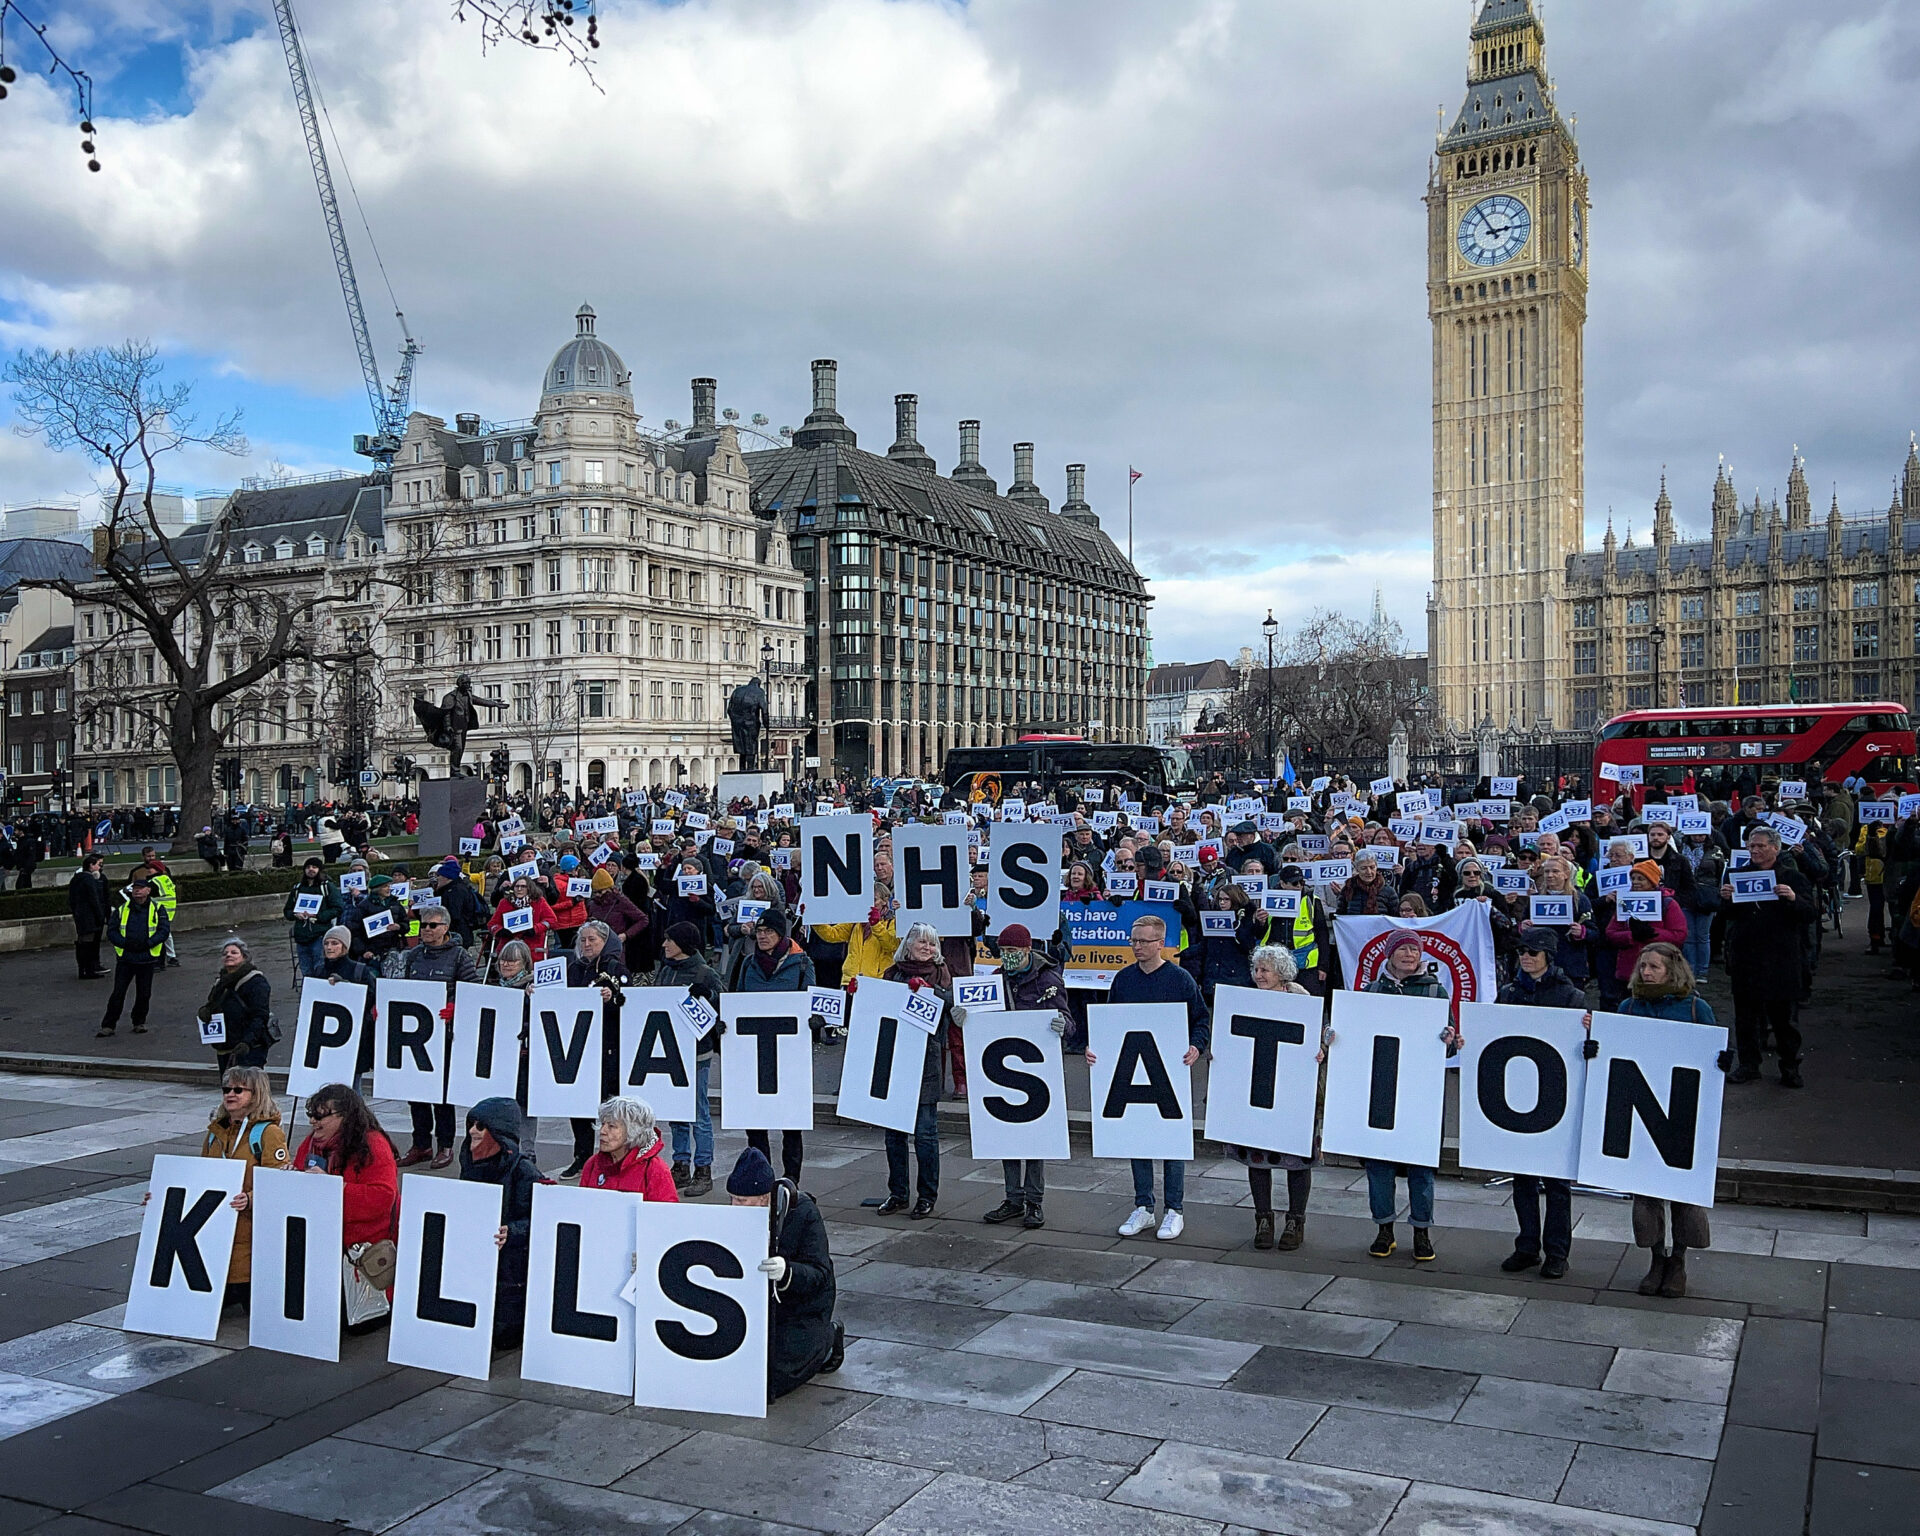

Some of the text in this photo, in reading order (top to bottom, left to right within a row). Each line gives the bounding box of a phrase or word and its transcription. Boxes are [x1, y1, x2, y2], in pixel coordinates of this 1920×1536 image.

[1407, 801, 1426, 811] 146
[1484, 805, 1504, 813] 363
[1648, 811, 1670, 820] 554
[1866, 808, 1886, 817] 211
[1395, 825, 1413, 834] 178
[1684, 820, 1705, 829] 557
[1431, 829, 1448, 839] 63
[1304, 840, 1321, 849] 116
[1322, 866, 1346, 878] 450
[685, 881, 698, 890] 29
[1116, 880, 1131, 889] 34
[1503, 877, 1520, 887] 38
[1605, 875, 1621, 887] 41
[1745, 880, 1763, 892] 16
[1243, 882, 1258, 892] 35
[1155, 889, 1168, 899] 11
[305, 900, 312, 908] 1
[1274, 898, 1289, 909] 13
[1630, 899, 1648, 911] 15
[1543, 904, 1560, 915] 14
[1084, 908, 1117, 922] have
[375, 919, 384, 928] 2
[515, 917, 522, 926] 4
[1212, 918, 1226, 929] 12
[1089, 951, 1127, 964] lives.
[538, 967, 561, 983] 487
[963, 986, 993, 1003] 541
[813, 997, 840, 1013] 466
[908, 998, 936, 1018] 528
[684, 998, 710, 1025] 239
[207, 1022, 218, 1034] 62
